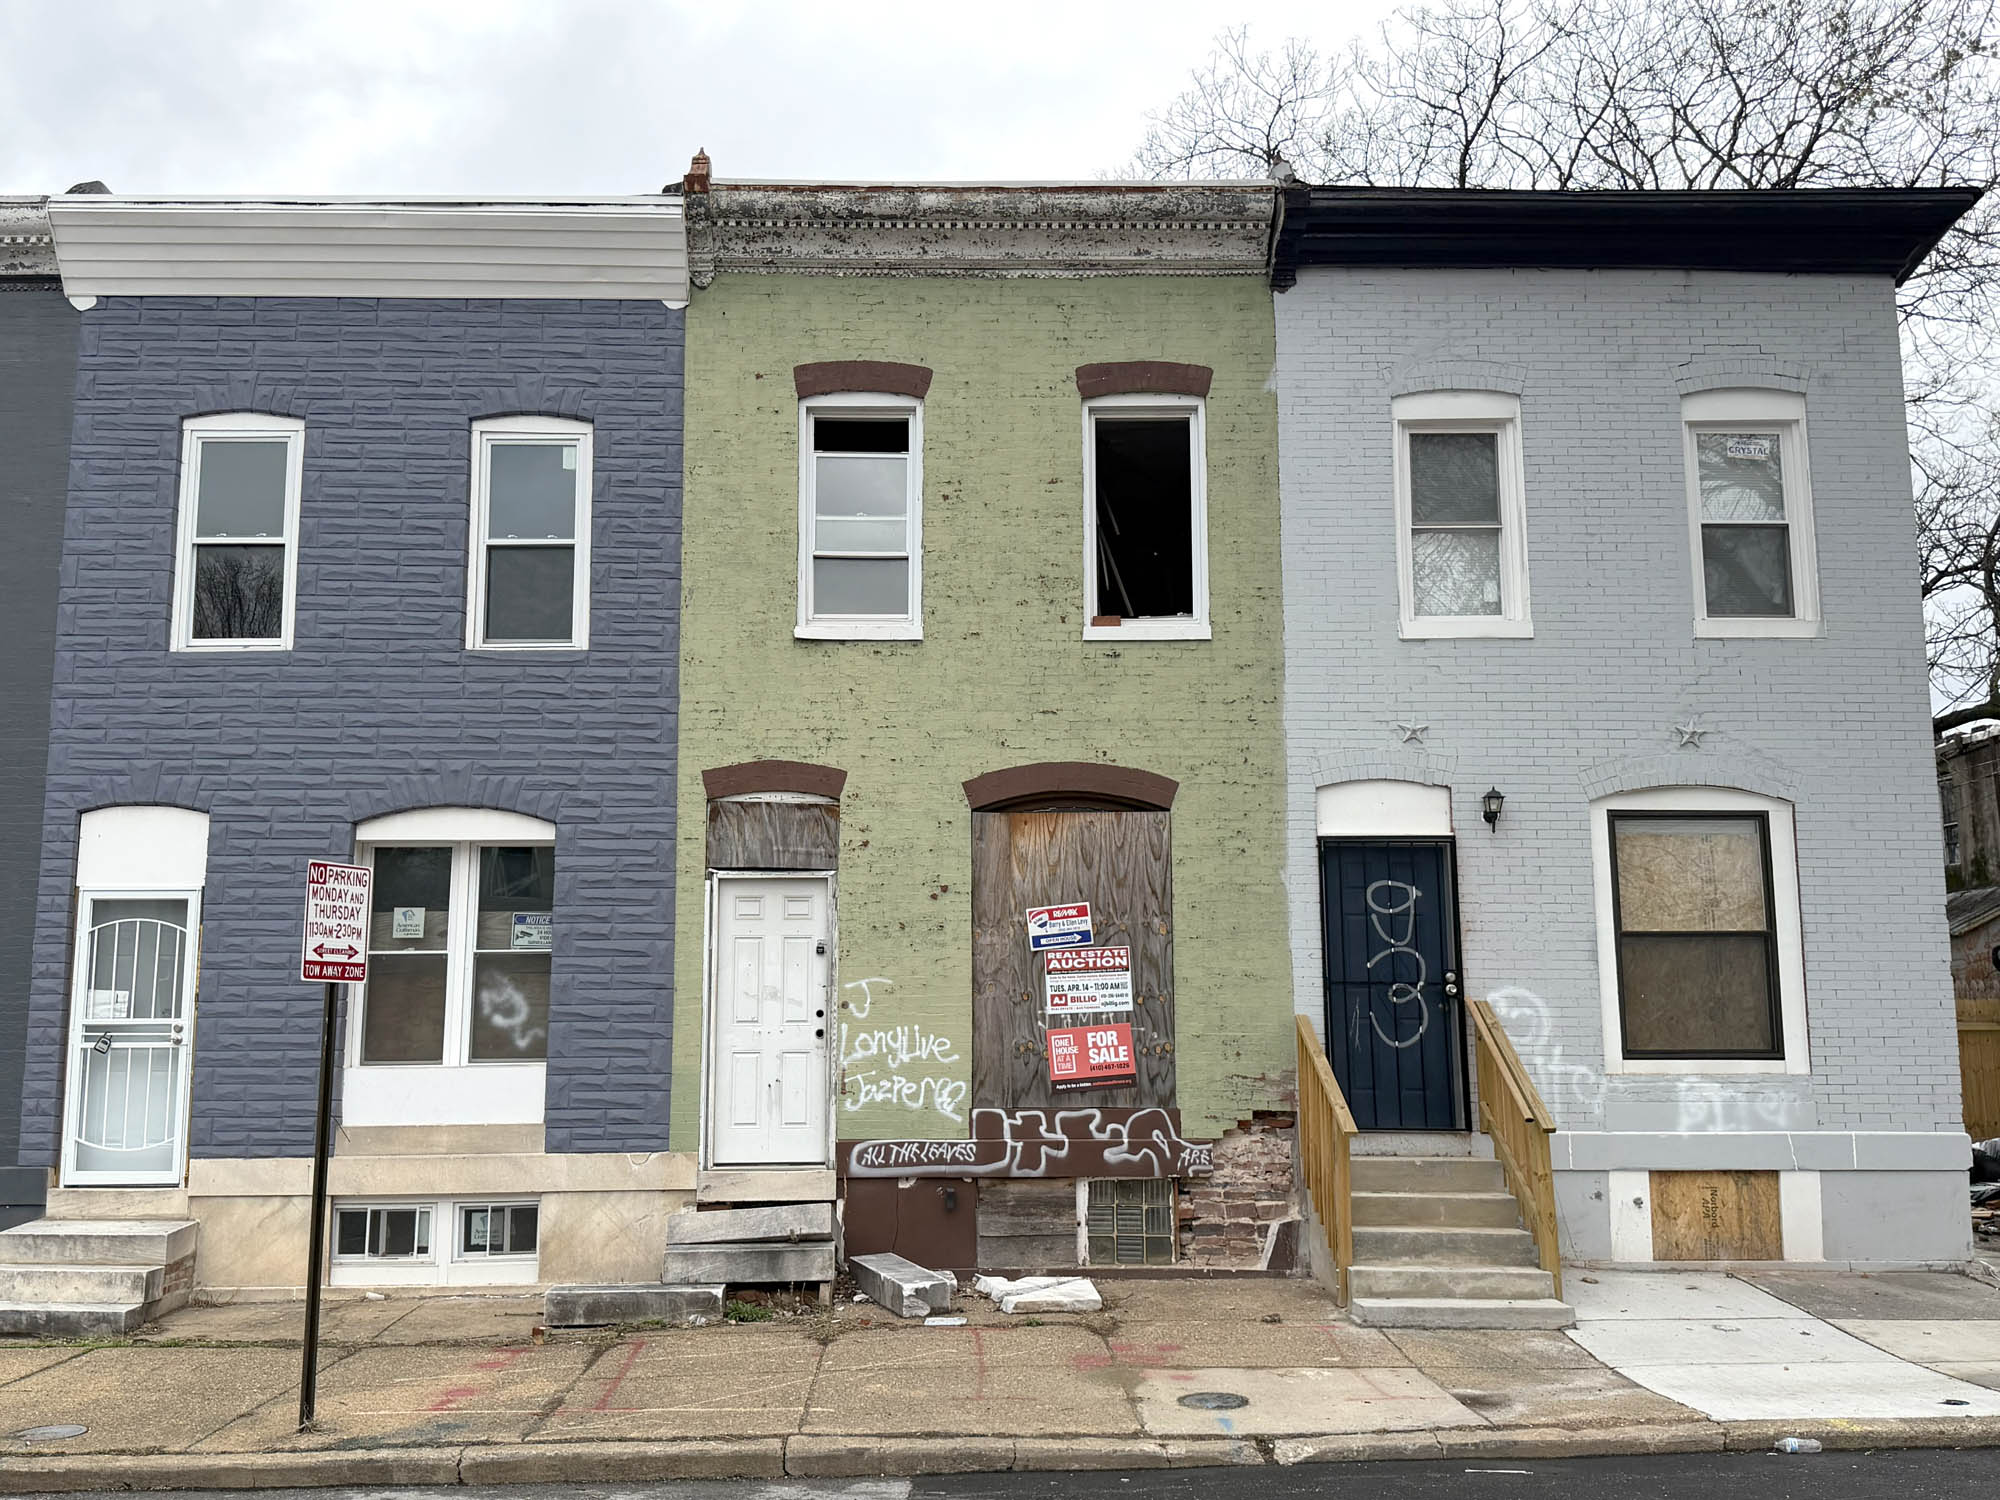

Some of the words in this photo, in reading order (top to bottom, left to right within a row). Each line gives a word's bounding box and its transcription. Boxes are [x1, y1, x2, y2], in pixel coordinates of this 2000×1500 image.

[1728, 446, 1768, 455] CRYSTAL
[310, 866, 325, 883] NO
[328, 869, 368, 888] PARKING
[312, 886, 349, 903] MONDAY
[350, 892, 365, 905] AND
[314, 904, 362, 921] THURSDAY
[1052, 908, 1079, 918] RE/MAX
[525, 915, 552, 925] NOTICE
[1047, 951, 1079, 960] REAL
[1080, 949, 1127, 958] ESTATE
[1048, 957, 1128, 969] AUCTION
[305, 965, 321, 977] TOW
[322, 965, 343, 977] AWAY
[344, 966, 364, 978] ZONE
[1050, 984, 1067, 993] TUES.
[1067, 983, 1081, 992] APR.
[1082, 983, 1089, 991] 14
[1109, 982, 1120, 991] AM
[1053, 996, 1066, 1005] AJ
[1070, 995, 1098, 1003] BILLIG
[1054, 1038, 1070, 1048] ONE
[1086, 1030, 1119, 1048] FOR
[1055, 1046, 1080, 1055] HOUSE
[1088, 1045, 1129, 1064] SALE
[1057, 1055, 1065, 1063] AT
[1057, 1062, 1073, 1070] TIME
[1710, 1189, 1720, 1229] Norbord
